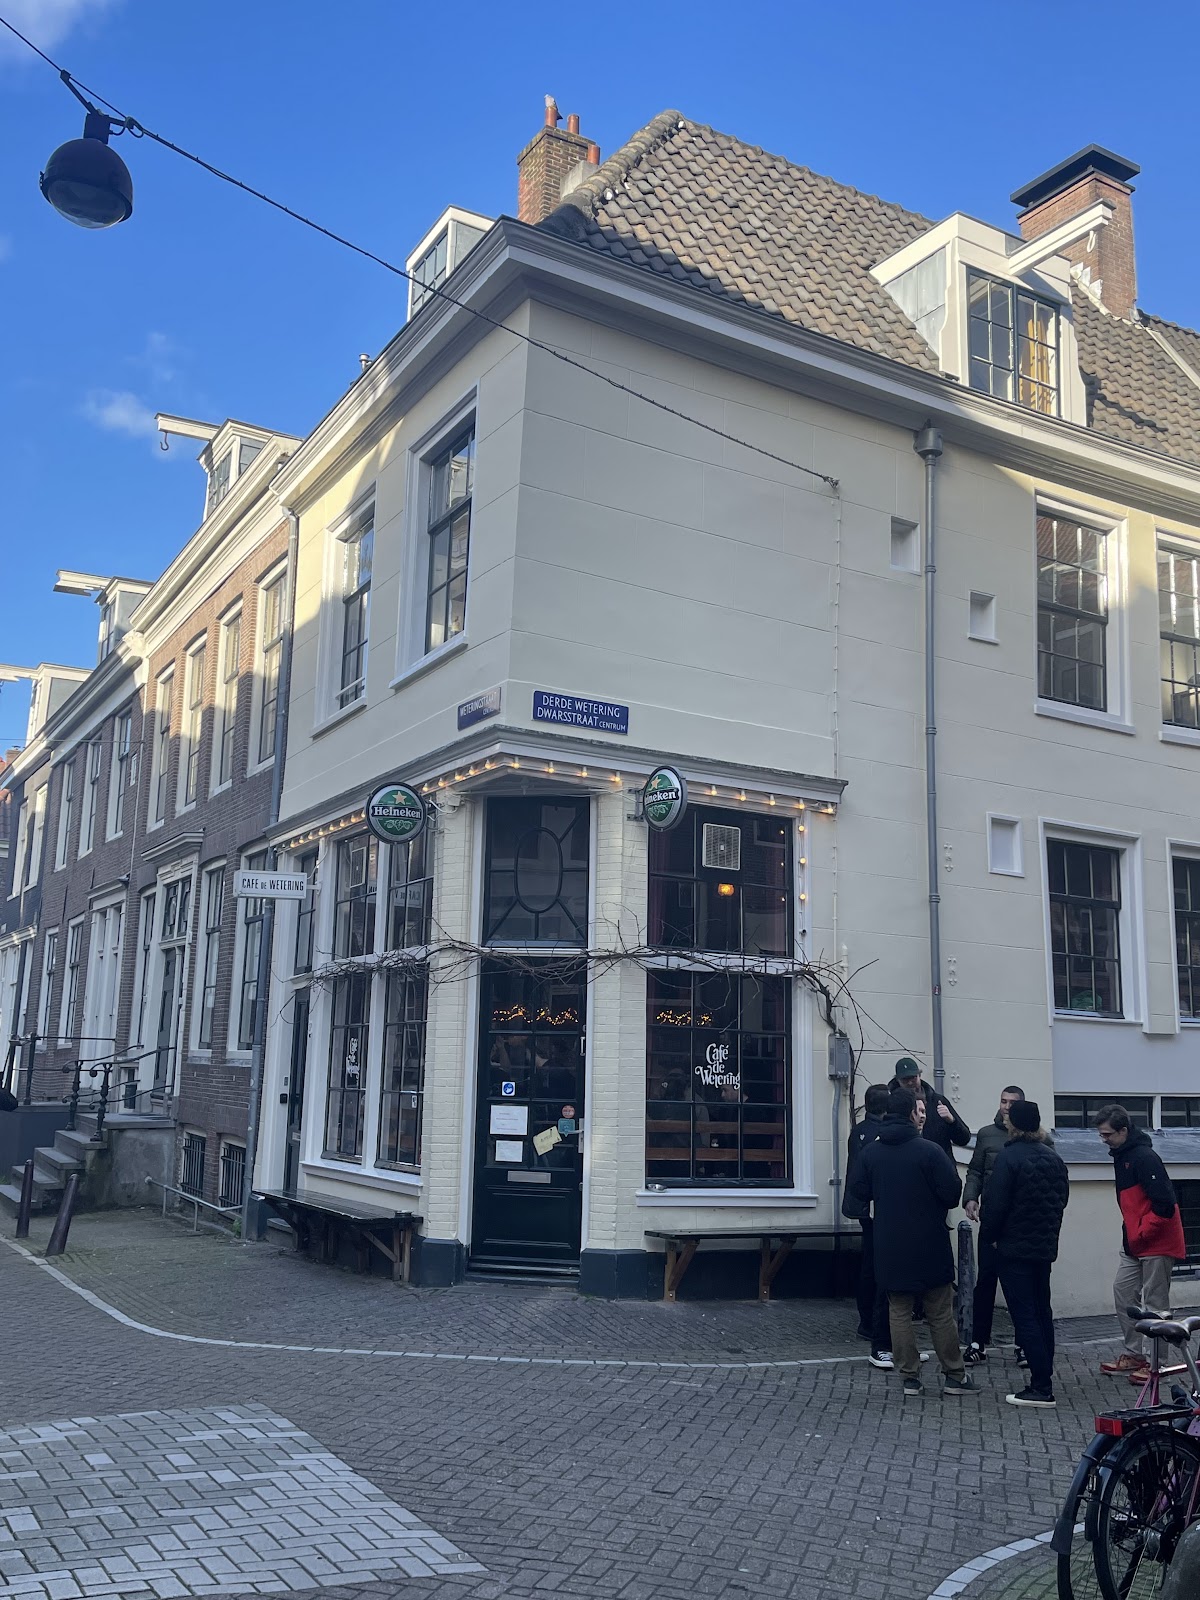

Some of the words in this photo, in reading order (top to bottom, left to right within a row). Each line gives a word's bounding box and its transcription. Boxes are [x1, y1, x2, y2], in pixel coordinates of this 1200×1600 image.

[542, 695, 573, 710] DERDE
[575, 700, 620, 718] WETERING
[537, 706, 599, 727] DWARSSTRAAT
[599, 720, 626, 731] CENTRUM
[373, 806, 421, 819] Heineken
[242, 878, 259, 889] CAFE
[269, 879, 304, 891] WETERING
[705, 1043, 729, 1065] Café
[694, 1065, 741, 1090] Wetering
[712, 1060, 725, 1073] de
